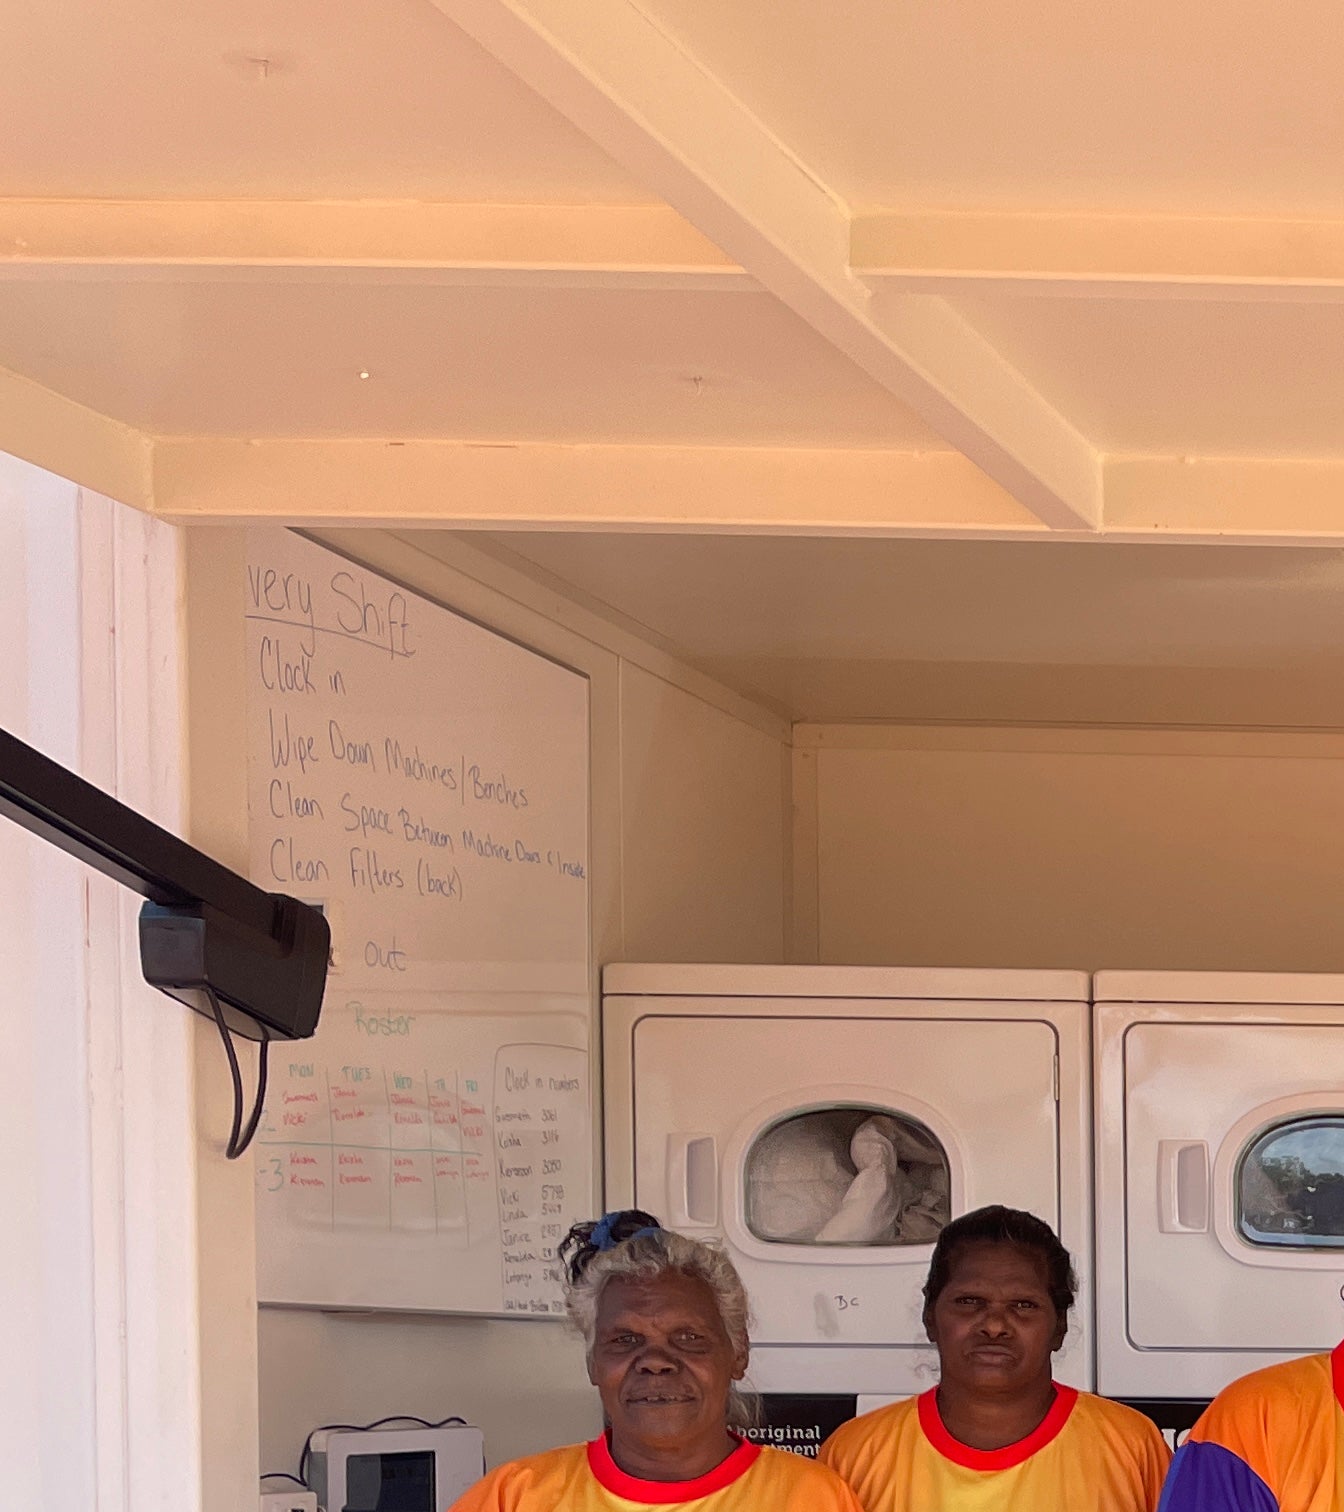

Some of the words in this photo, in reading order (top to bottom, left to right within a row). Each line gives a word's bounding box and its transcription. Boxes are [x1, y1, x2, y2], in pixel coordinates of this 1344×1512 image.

[331, 572, 416, 660] Shift
[260, 636, 316, 694] Clock
[330, 671, 346, 695] in
[269, 708, 318, 773] Wipe
[329, 720, 375, 772] Down
[270, 779, 324, 819] Clean
[341, 793, 393, 836] Space
[270, 838, 329, 883] Clean
[350, 847, 404, 893] Filters
[365, 936, 407, 971] Out
[345, 1000, 416, 1037] Roster
[288, 1063, 314, 1079] MON
[341, 1066, 372, 1082] TUES
[505, 1066, 529, 1092] Clock
[727, 1425, 820, 1442] boriginal
